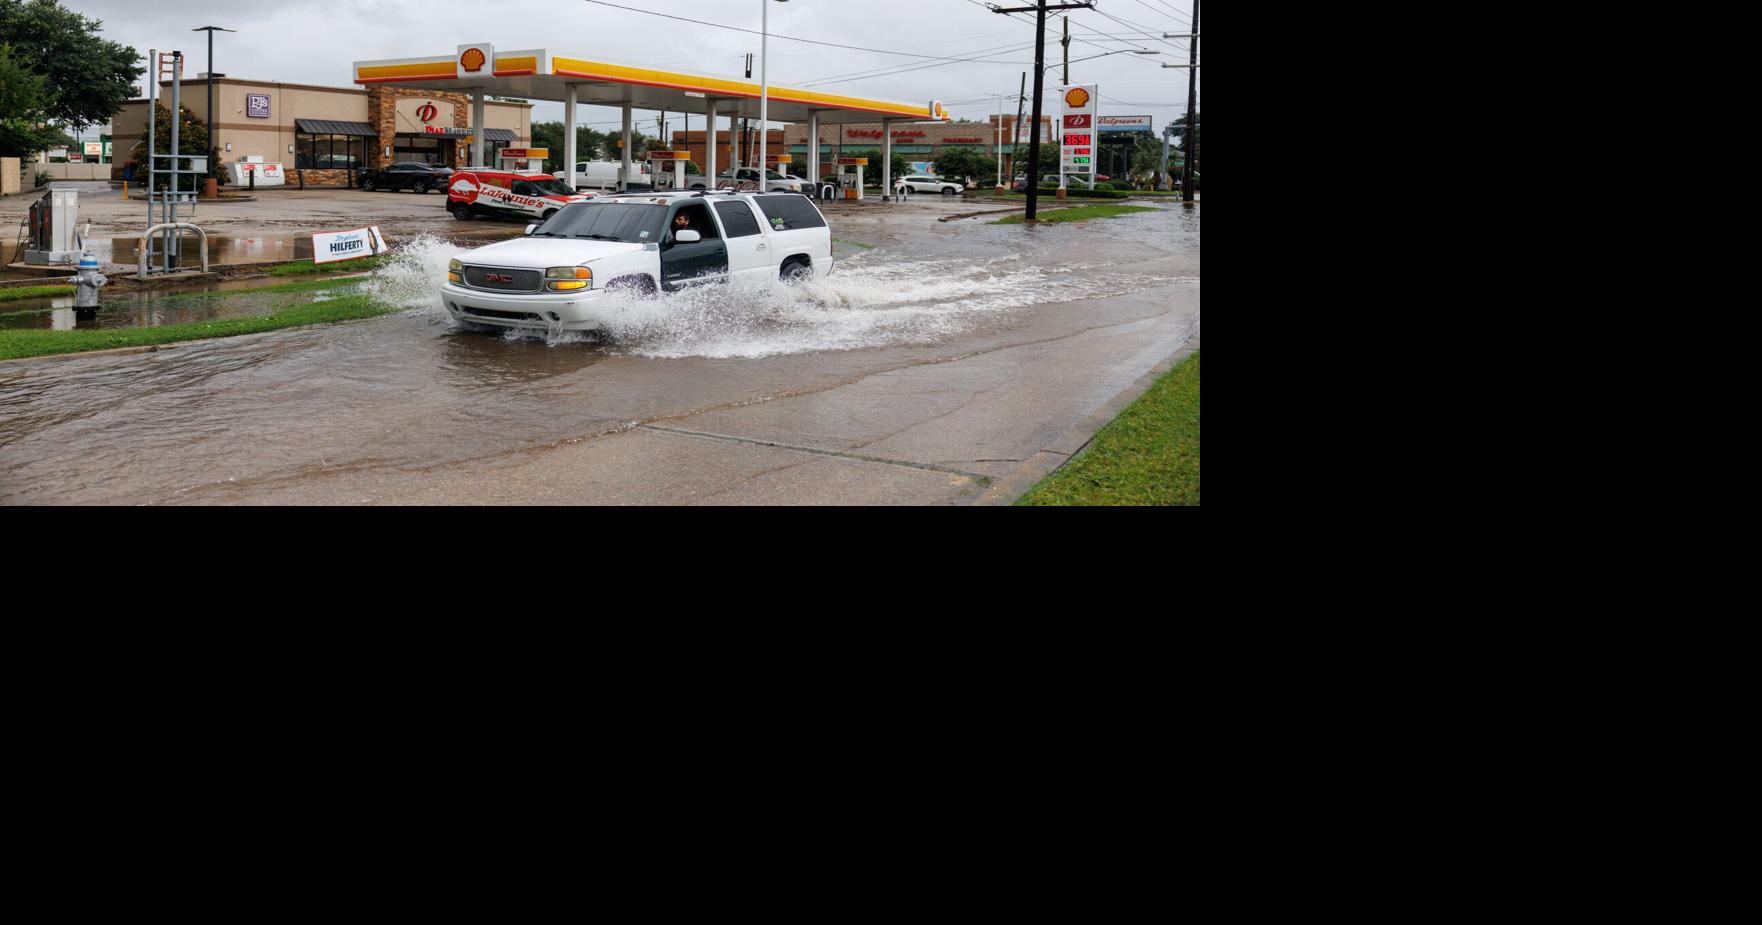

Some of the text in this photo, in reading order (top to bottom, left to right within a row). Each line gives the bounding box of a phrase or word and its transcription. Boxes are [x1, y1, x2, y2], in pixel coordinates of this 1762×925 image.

[847, 130, 926, 138] Walgeens
[330, 240, 364, 252] HILFERTY
[486, 273, 513, 283] GMC
